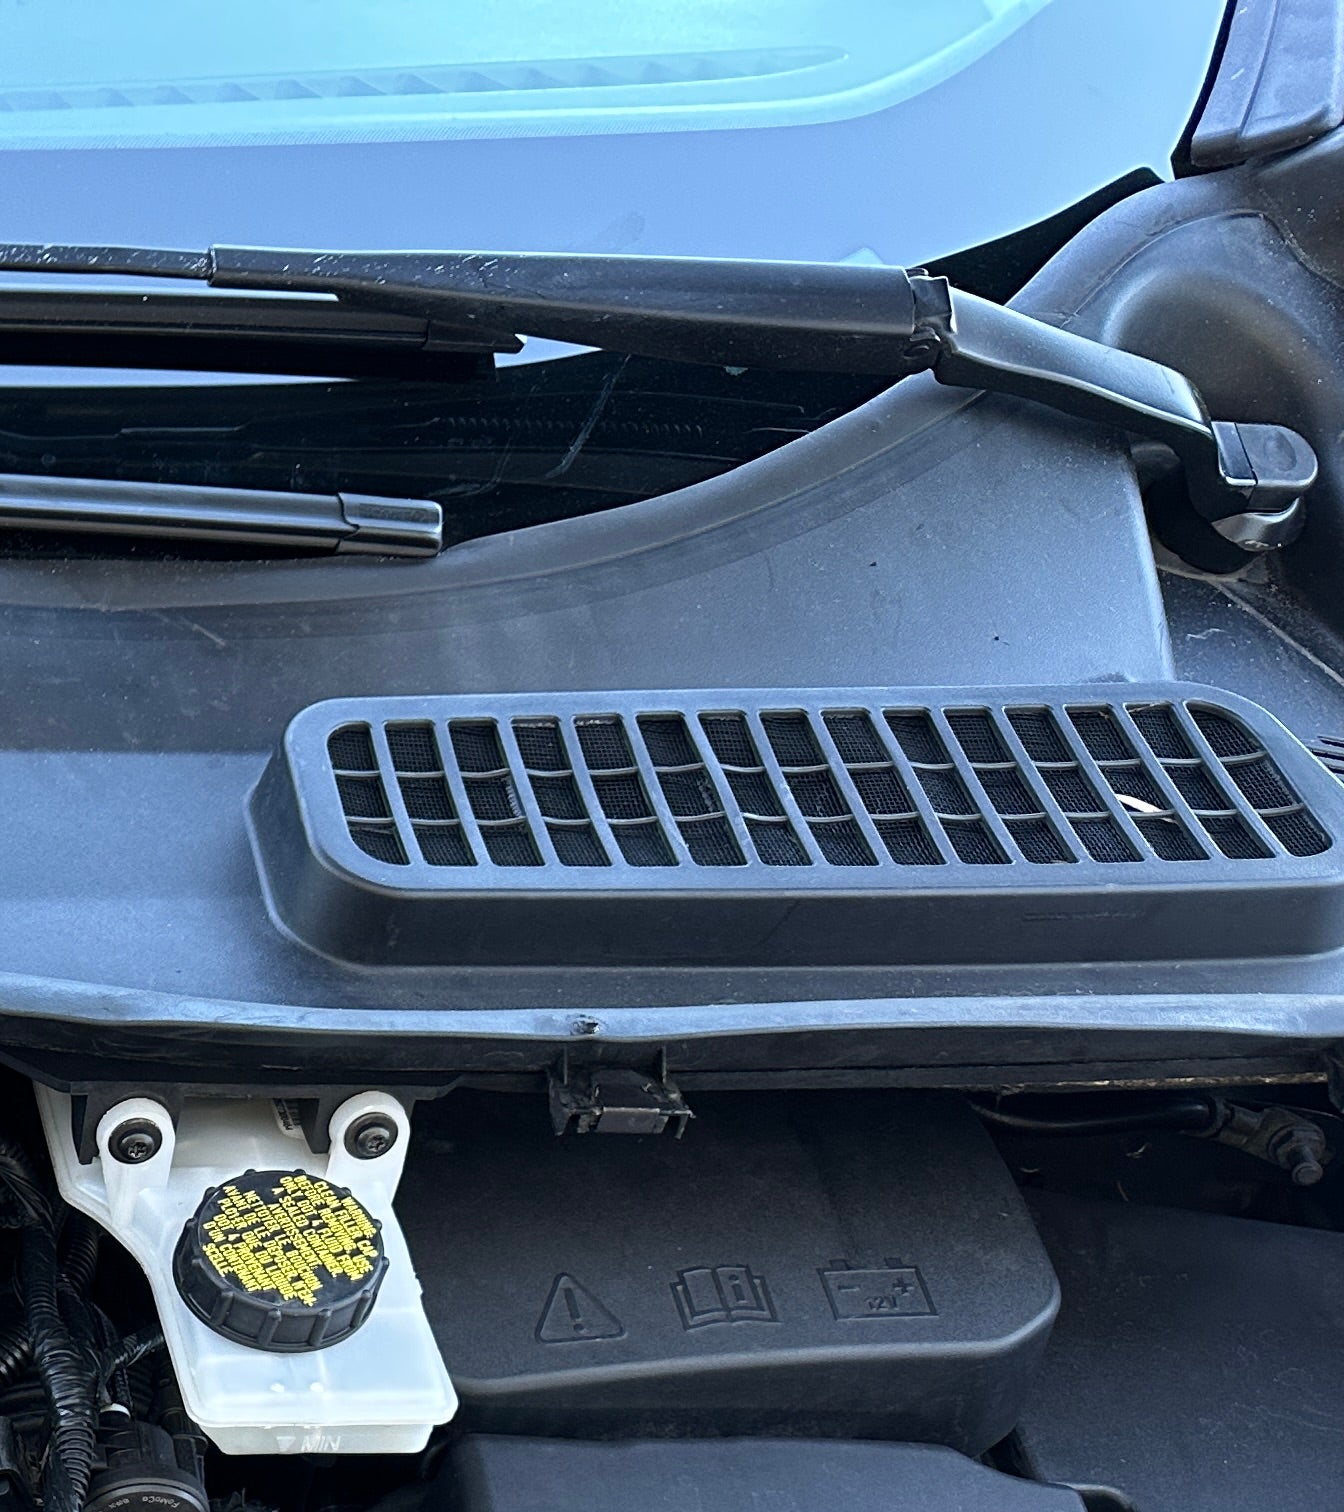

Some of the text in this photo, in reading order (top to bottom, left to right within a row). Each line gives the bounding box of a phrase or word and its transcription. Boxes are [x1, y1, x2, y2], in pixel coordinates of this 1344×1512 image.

[223, 1185, 251, 1211] AVANT
[244, 1212, 261, 1226] DE
[254, 1226, 271, 1239] LE
[243, 1189, 323, 1291] NETTOYER LE BOUCHON
[271, 1187, 285, 1195] A
[279, 1195, 310, 1227] SEALED
[280, 1176, 363, 1281] ONLY DOT 4 FLUID FROM
[294, 1175, 325, 1207] BEFORE
[352, 1254, 373, 1274] USE
[314, 1181, 379, 1257] CLEAN FILLER CAP
[341, 1196, 377, 1239] WARNING:
[213, 1213, 236, 1231] DOT
[233, 1241, 277, 1291] PROVENANT
[217, 1198, 298, 1301] PLOYER QUE DU LIQUIDE
[219, 1243, 262, 1292] CONTENANT
[300, 1434, 342, 1452] MIN
